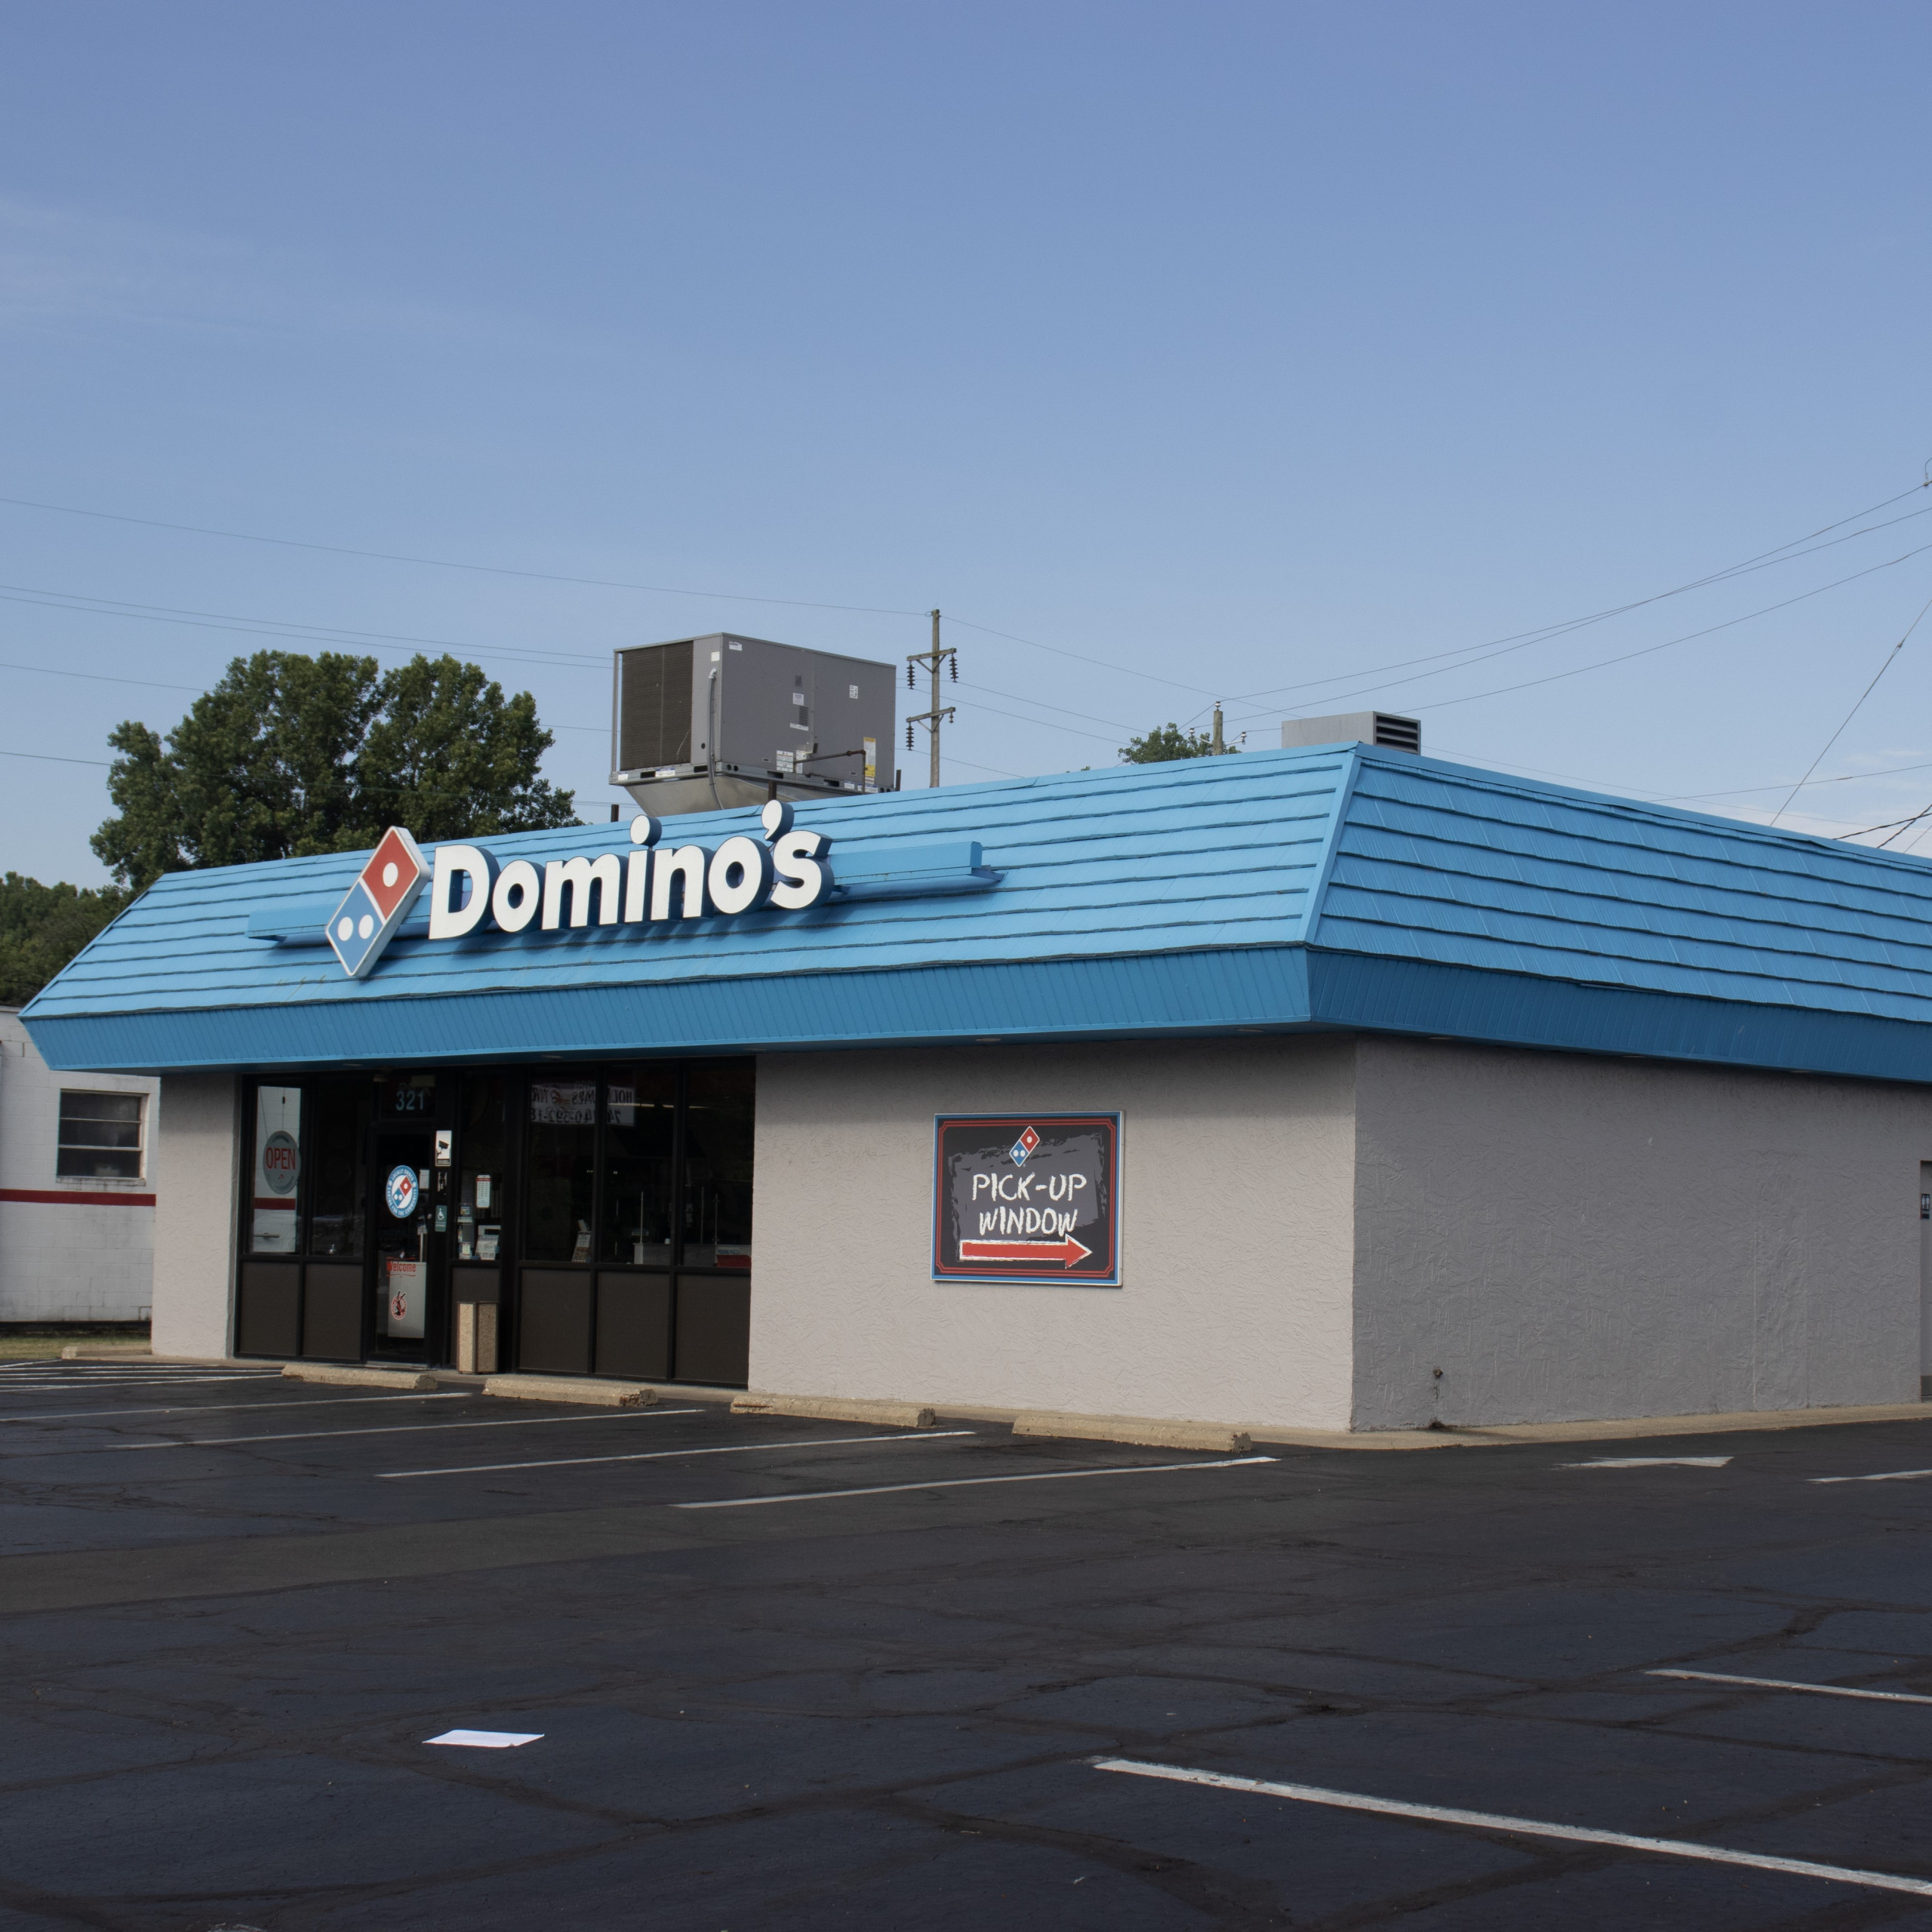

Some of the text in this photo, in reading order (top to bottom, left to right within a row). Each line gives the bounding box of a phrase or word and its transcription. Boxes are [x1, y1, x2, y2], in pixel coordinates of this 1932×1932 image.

[428, 799, 832, 940] Domino's
[395, 1089, 424, 1112] 321
[265, 1146, 296, 1171] OPEN
[972, 1172, 1087, 1201] PICK-UP
[979, 1206, 1078, 1237] WINDOW
[386, 1260, 417, 1272] Welcome
